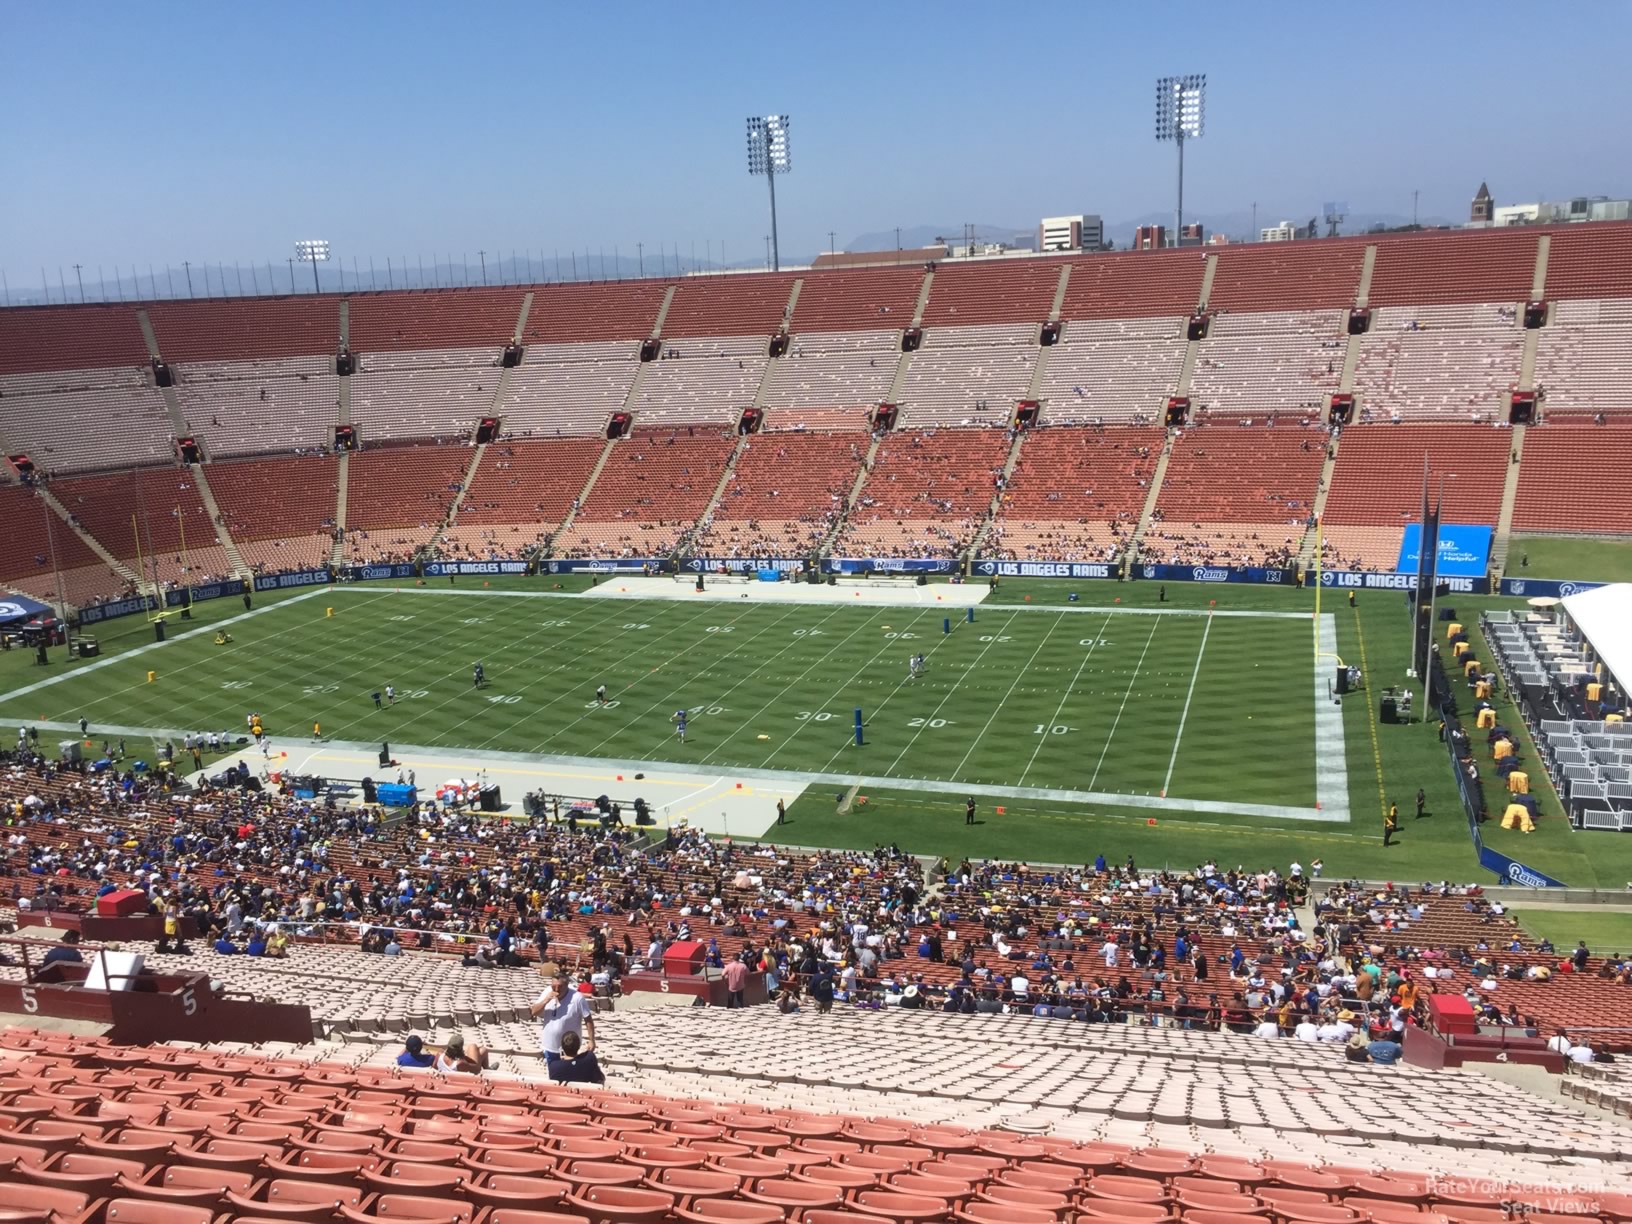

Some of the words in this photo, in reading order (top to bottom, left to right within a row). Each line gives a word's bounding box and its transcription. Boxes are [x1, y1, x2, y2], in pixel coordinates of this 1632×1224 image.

[442, 563, 458, 574] LOS
[460, 563, 499, 573] ANGELES
[998, 563, 1018, 575] LOS
[1020, 563, 1070, 576] ANGELES
[1072, 564, 1109, 577] RAMS
[1193, 566, 1228, 581] Rams
[256, 576, 277, 590] LOS
[279, 571, 329, 587] ANGELES
[1338, 573, 1362, 587] LOS
[82, 608, 103, 623] LOS
[105, 596, 154, 616] ANGELES
[687, 705, 724, 715] 40
[794, 711, 833, 722] 30
[907, 717, 947, 728] 20
[1033, 724, 1068, 735] 10
[1508, 862, 1547, 887] Rams
[44, 916, 52, 927] 6
[660, 980, 669, 992] 5
[21, 988, 39, 1013] 5
[183, 989, 197, 1016] 5
[1496, 1052, 1508, 1062] 4
